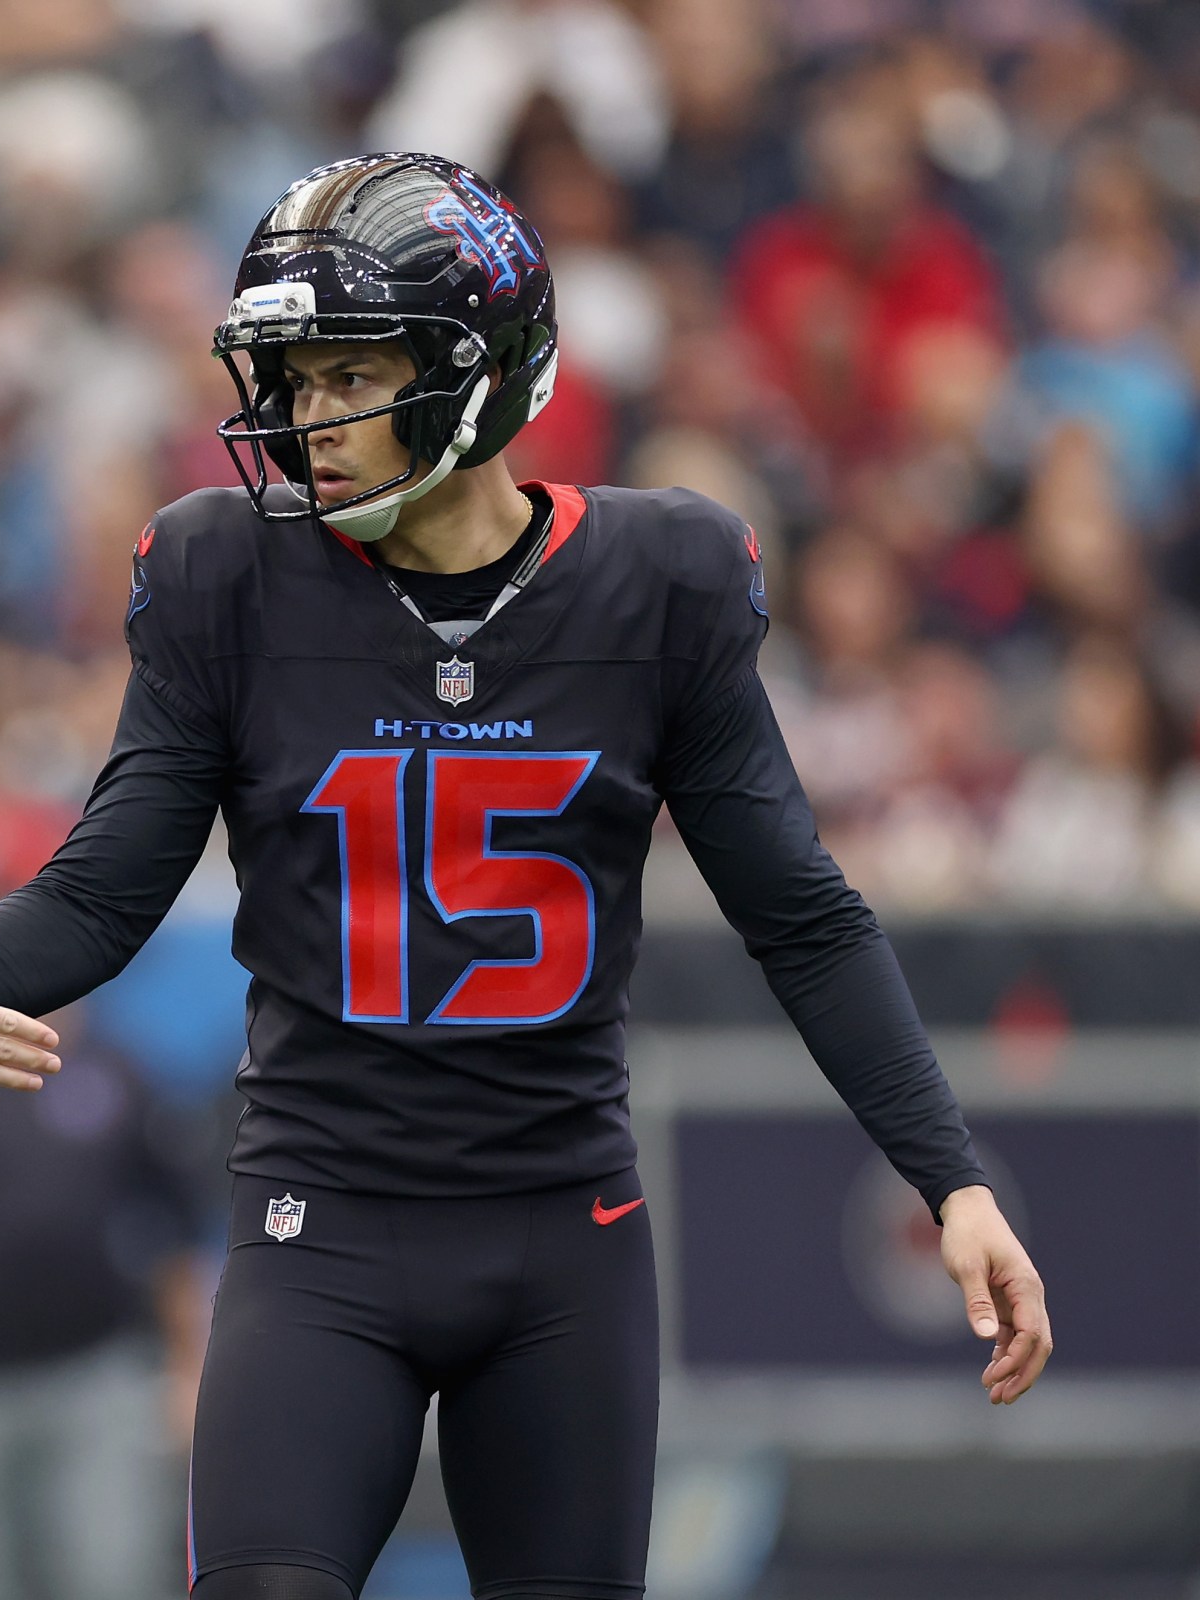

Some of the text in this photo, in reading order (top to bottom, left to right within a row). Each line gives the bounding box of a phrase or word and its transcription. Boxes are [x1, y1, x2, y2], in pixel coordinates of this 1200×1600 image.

[442, 679, 469, 698] NFL
[373, 717, 534, 741] H-TOWN
[299, 747, 602, 1026] 15
[271, 1215, 296, 1233] NFL
